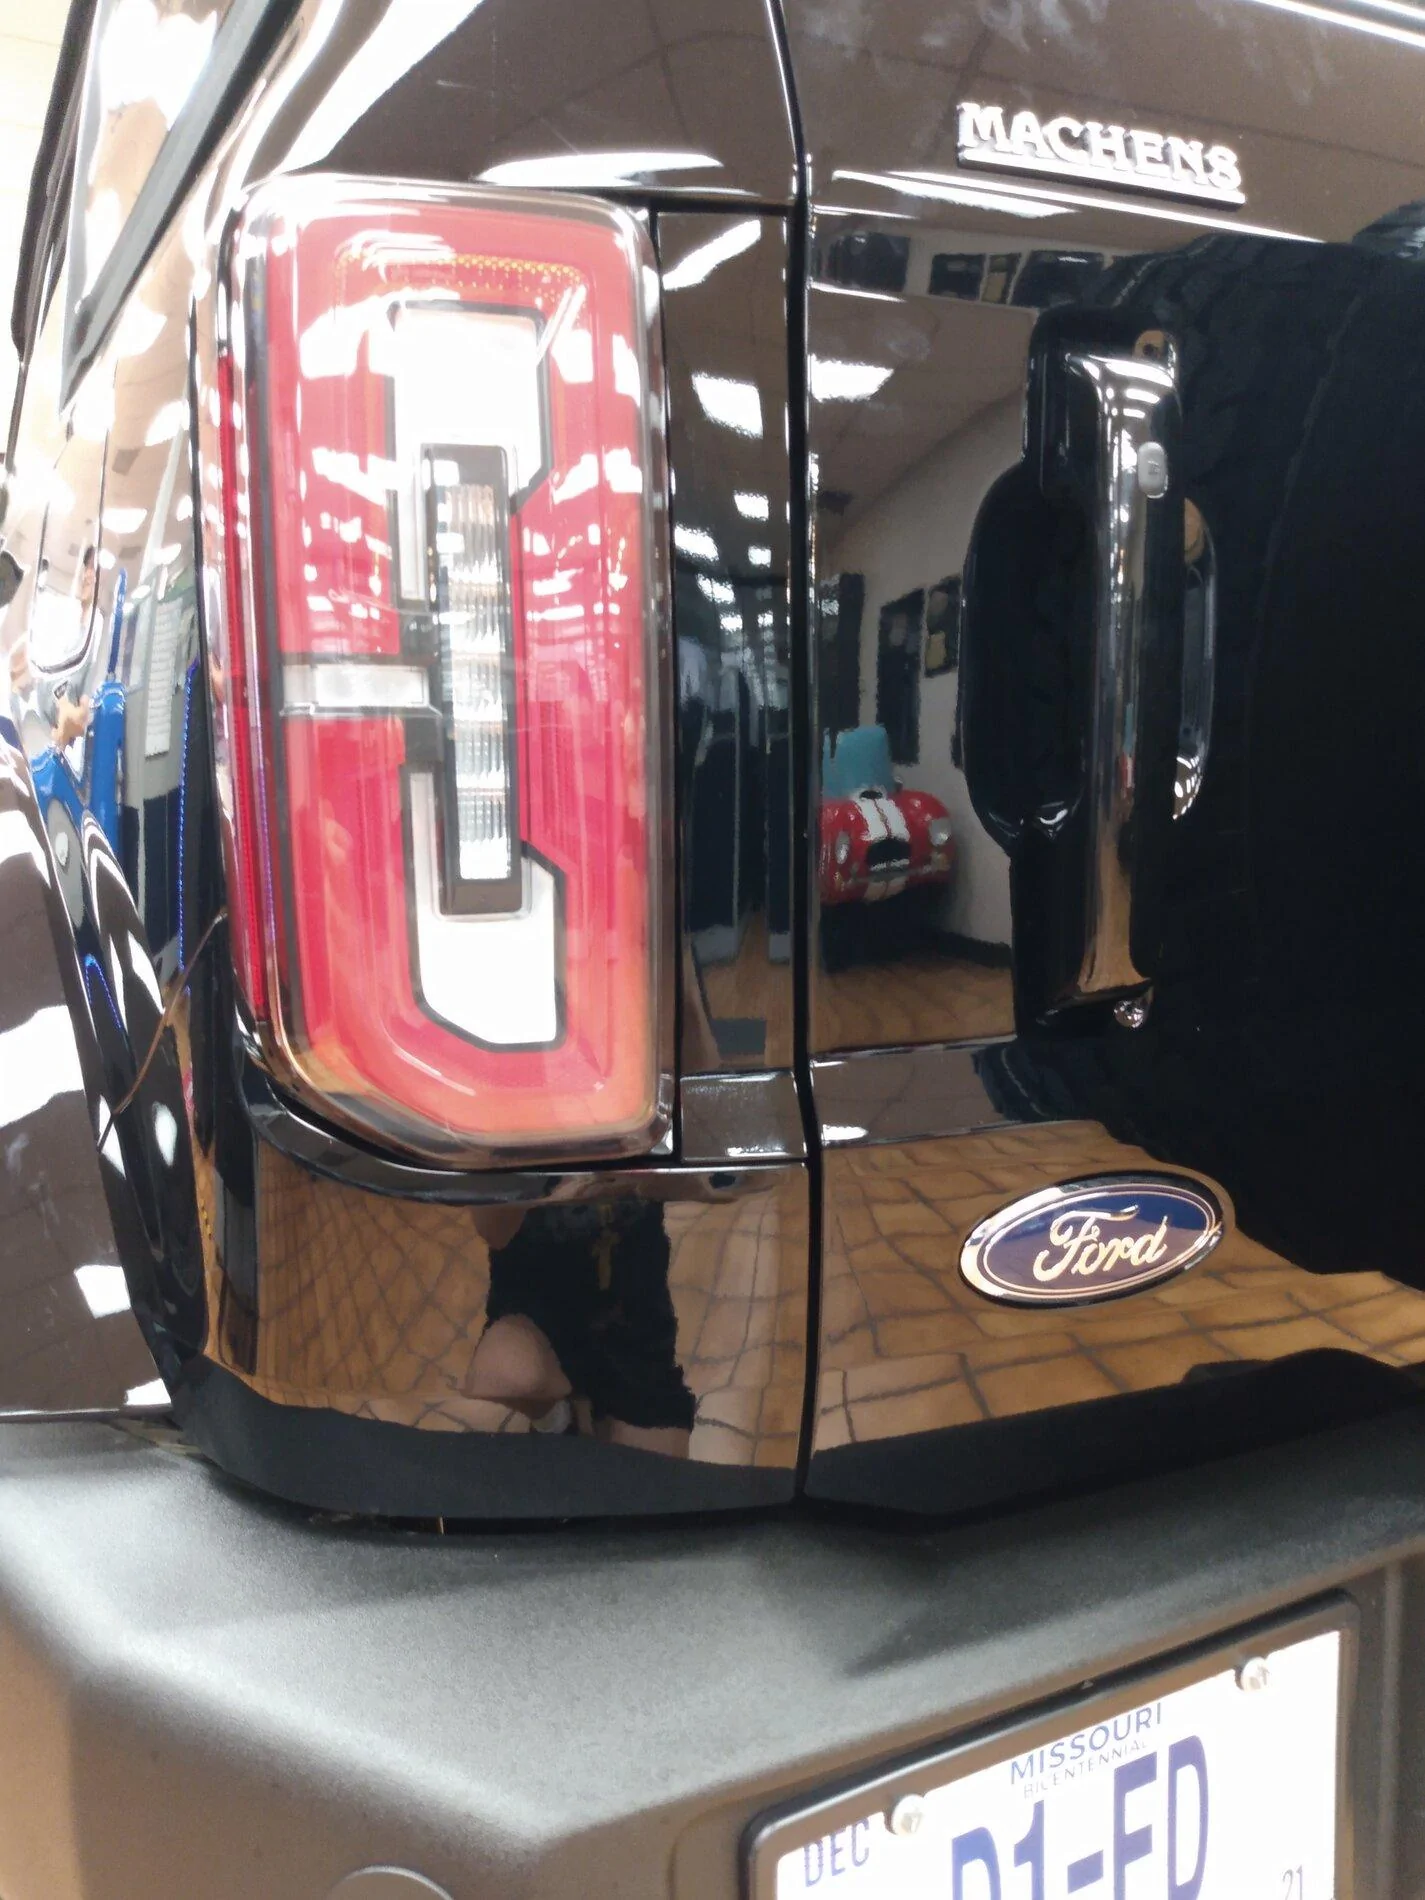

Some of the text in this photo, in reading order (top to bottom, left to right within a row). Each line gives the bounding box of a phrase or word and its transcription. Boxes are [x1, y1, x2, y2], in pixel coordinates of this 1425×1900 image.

[957, 102, 1242, 190] MACHENS
[1032, 1204, 1168, 1281] Ford
[1011, 1702, 1161, 1785] MISSOURI
[1023, 1740, 1147, 1799] BICENTENNIAL
[803, 1817, 870, 1888] DEC
